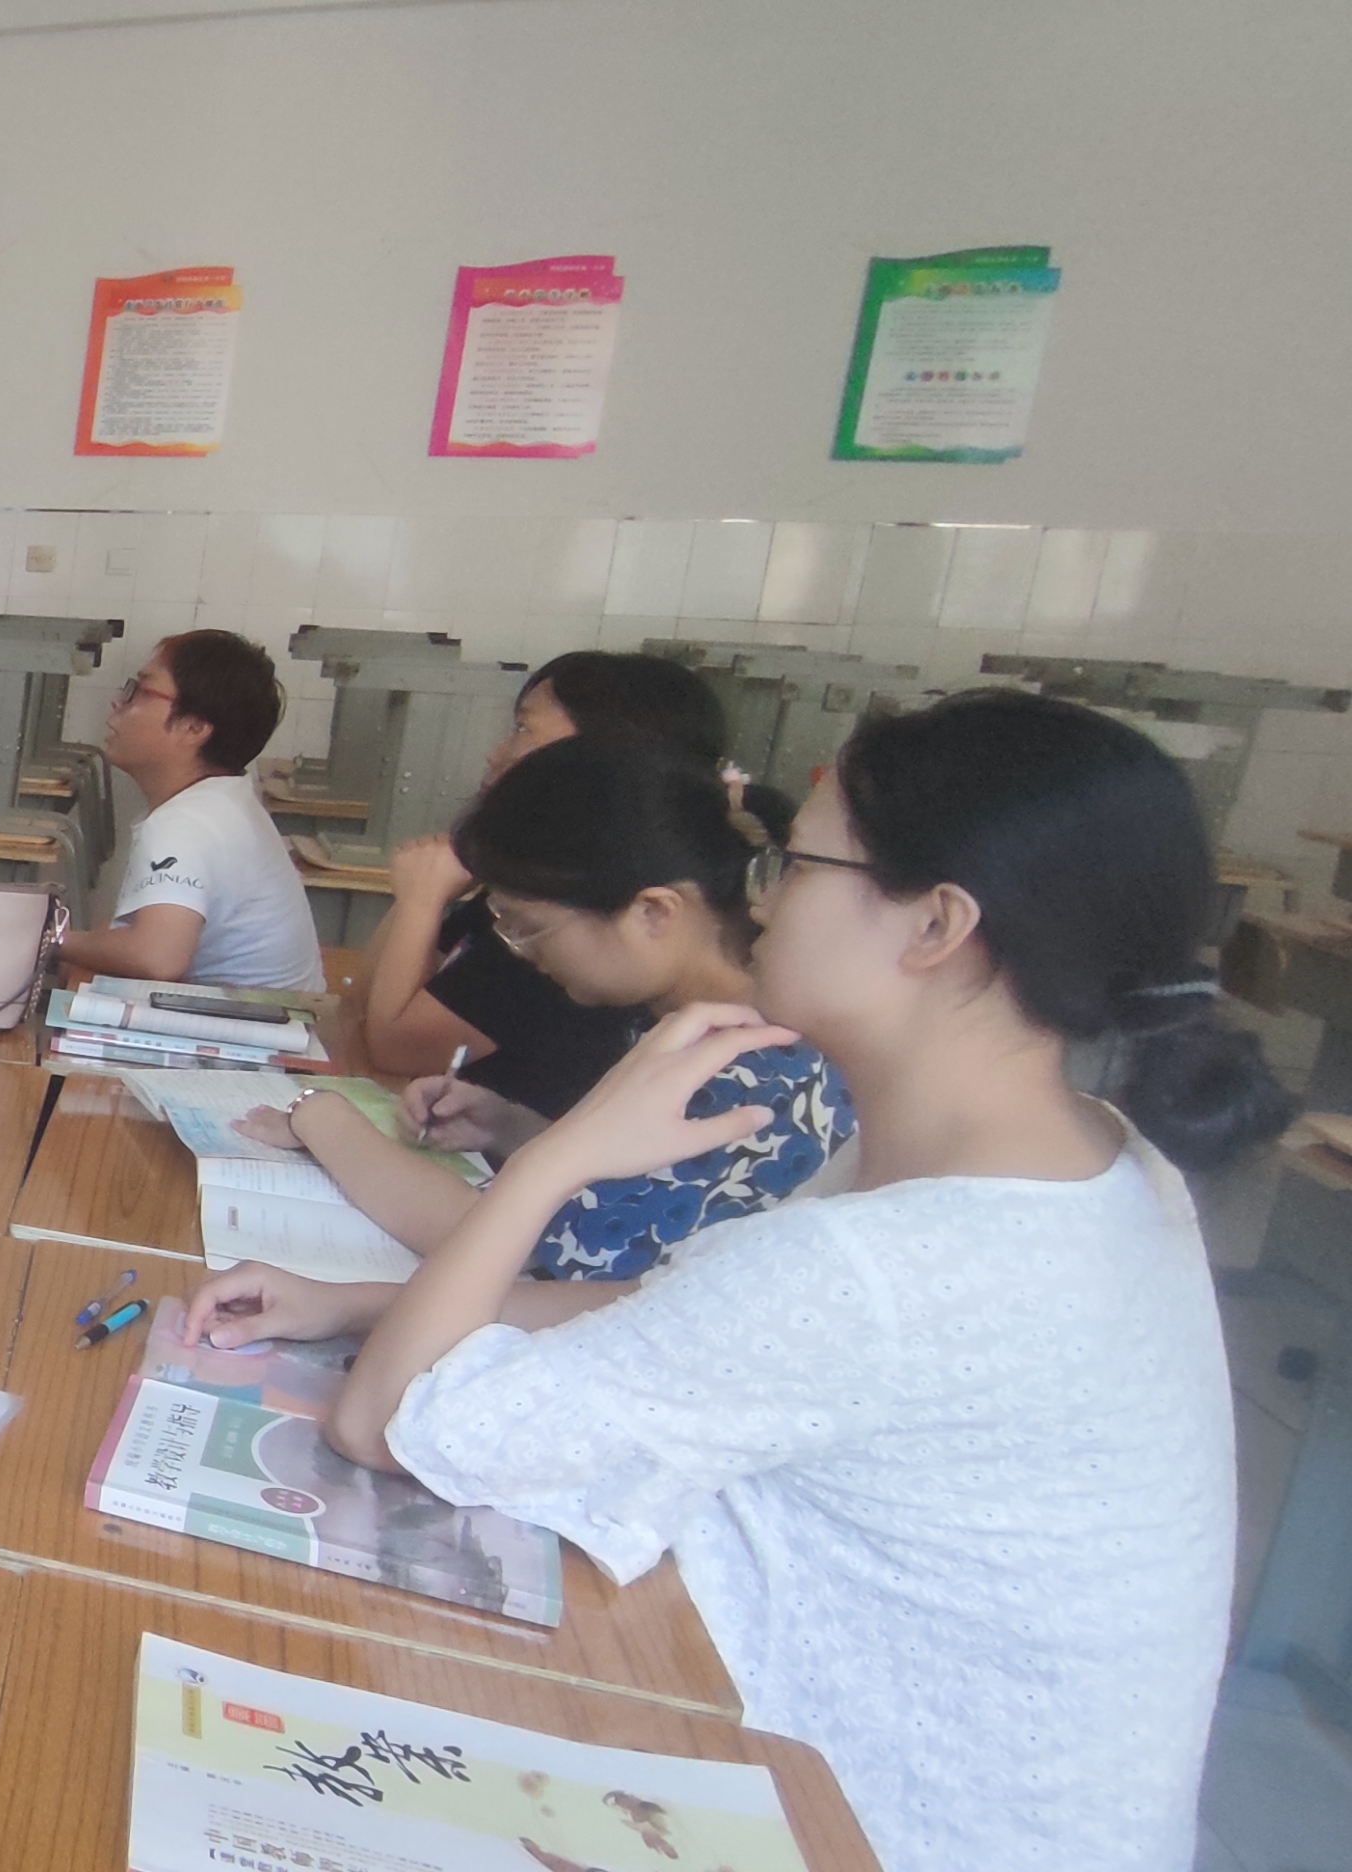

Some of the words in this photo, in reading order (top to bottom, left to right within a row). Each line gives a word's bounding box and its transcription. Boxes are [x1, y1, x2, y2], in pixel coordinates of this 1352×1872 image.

[144, 1403, 201, 1491] 教学设计与指导
